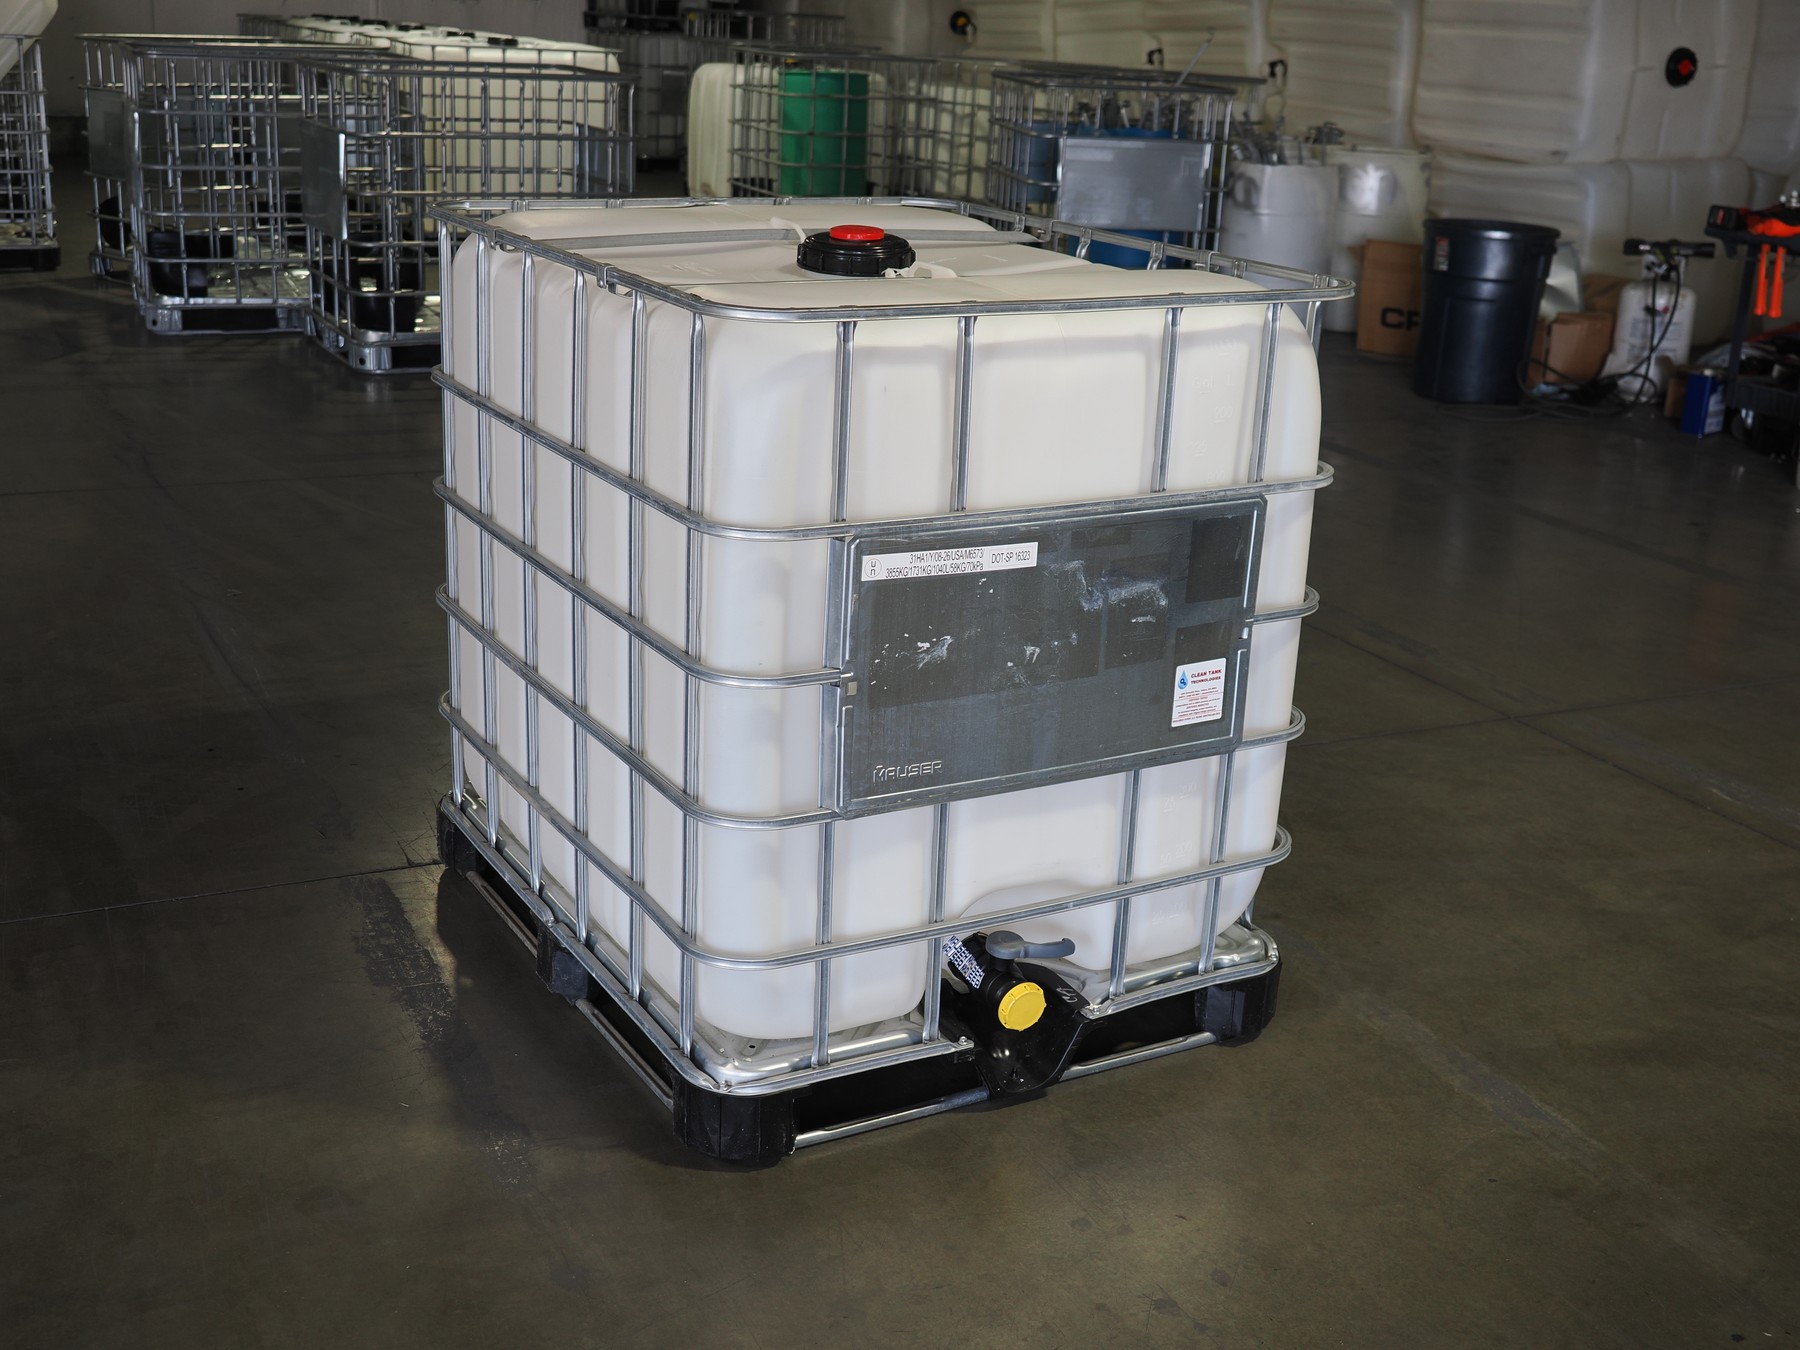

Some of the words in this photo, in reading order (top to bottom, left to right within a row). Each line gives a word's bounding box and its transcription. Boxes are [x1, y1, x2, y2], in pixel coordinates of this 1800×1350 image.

[991, 552, 1014, 564] DOT-SP
[1015, 550, 1031, 561] 16323
[1191, 676, 1221, 684] TECHNOLOGIES
[873, 760, 943, 783] MAUSER
